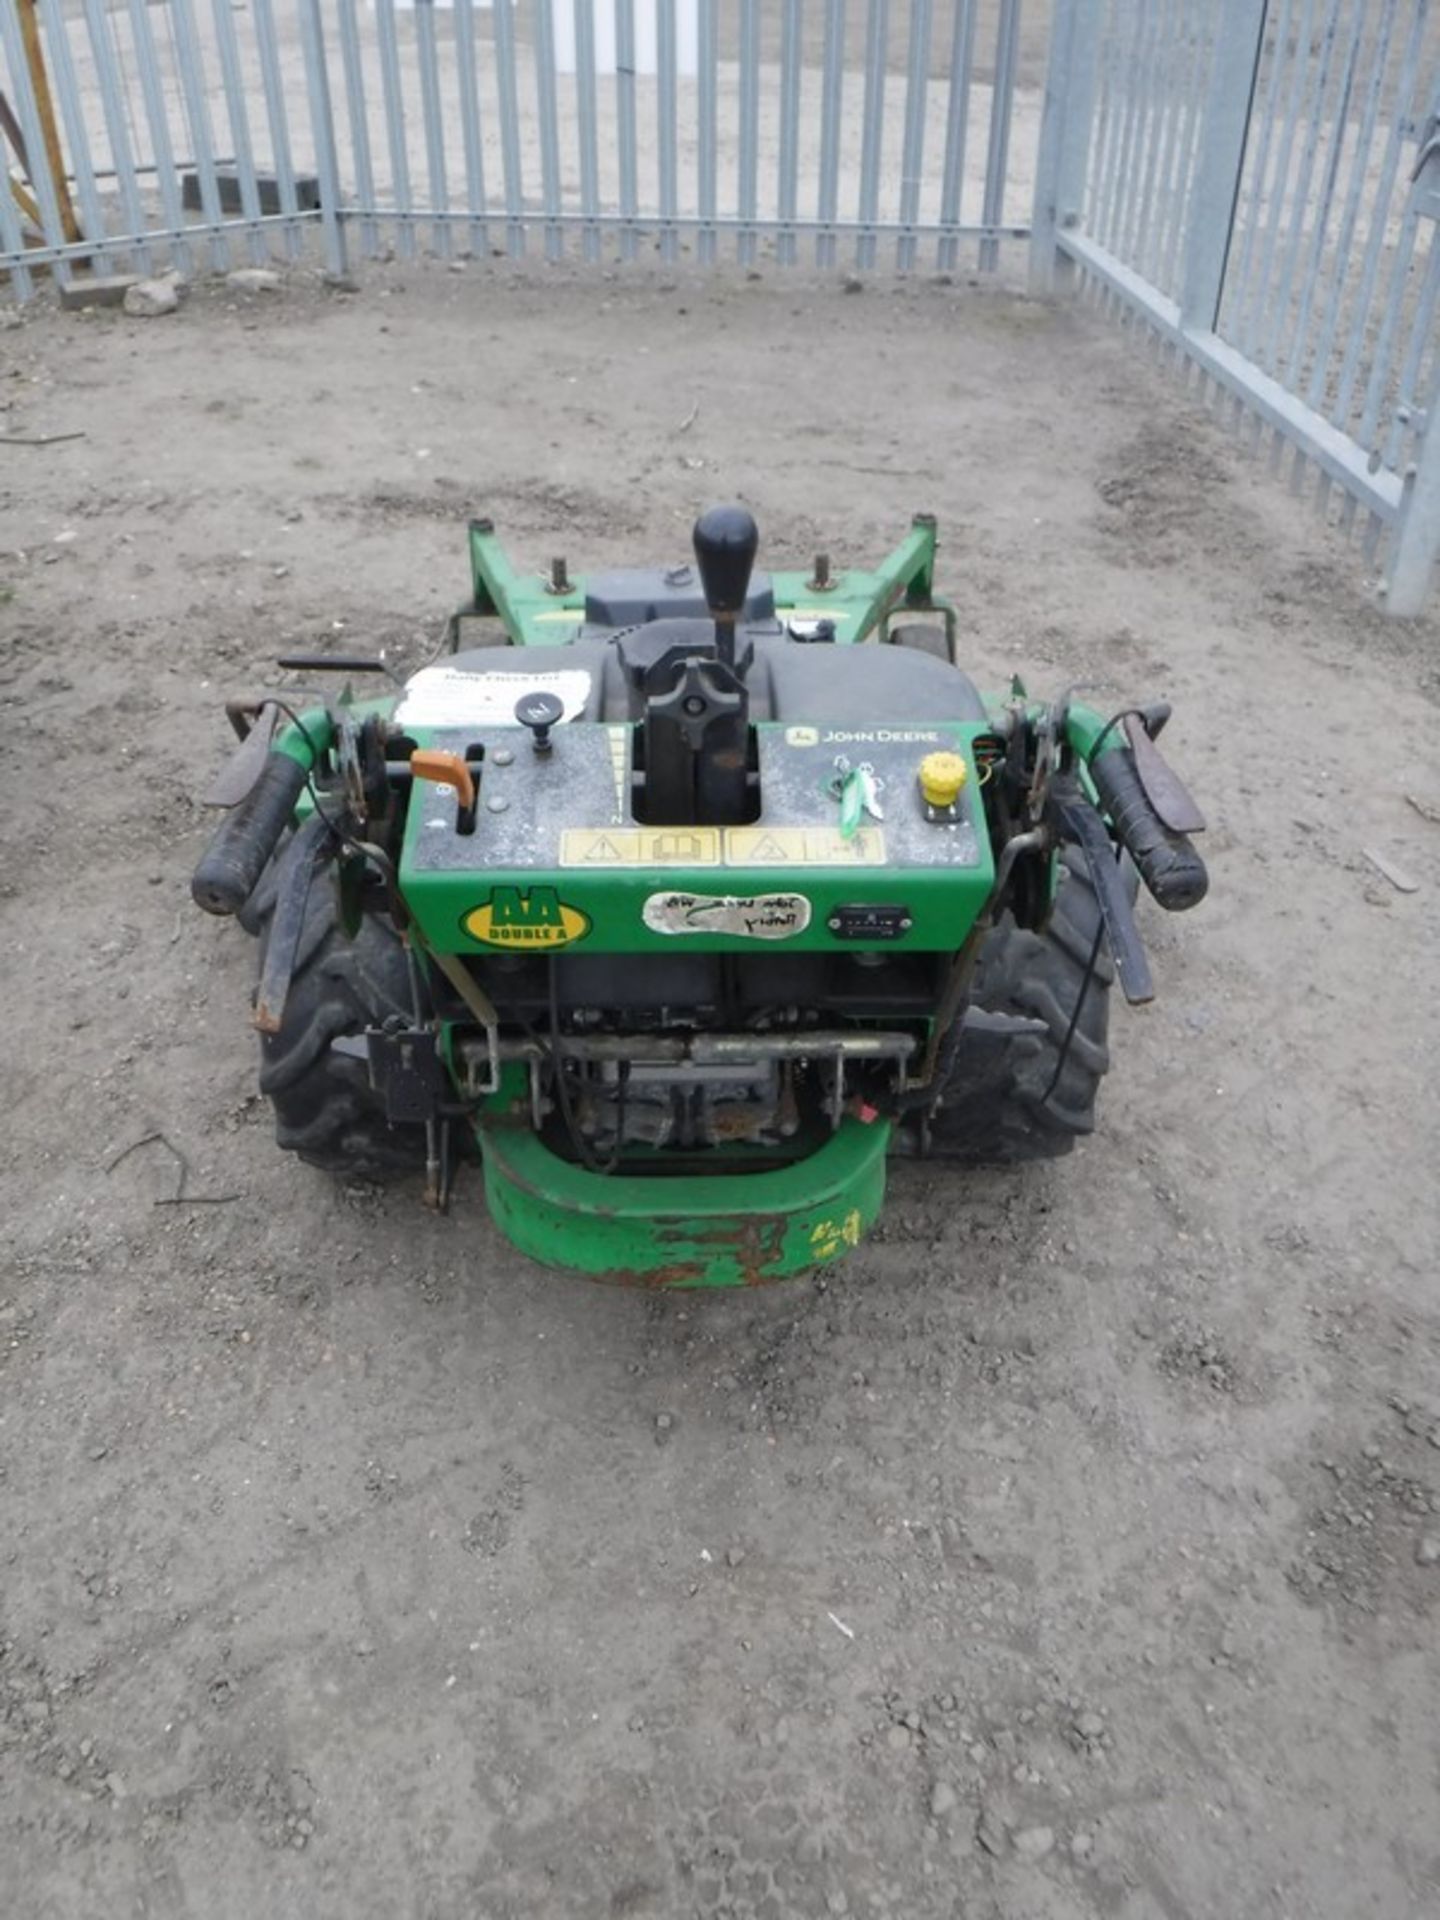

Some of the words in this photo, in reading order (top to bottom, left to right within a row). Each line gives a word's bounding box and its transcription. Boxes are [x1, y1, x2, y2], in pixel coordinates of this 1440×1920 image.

[822, 730, 874, 743] JOHN
[877, 730, 939, 743] DEERE
[488, 927, 552, 939] DOUBLE
[556, 927, 568, 939] A
